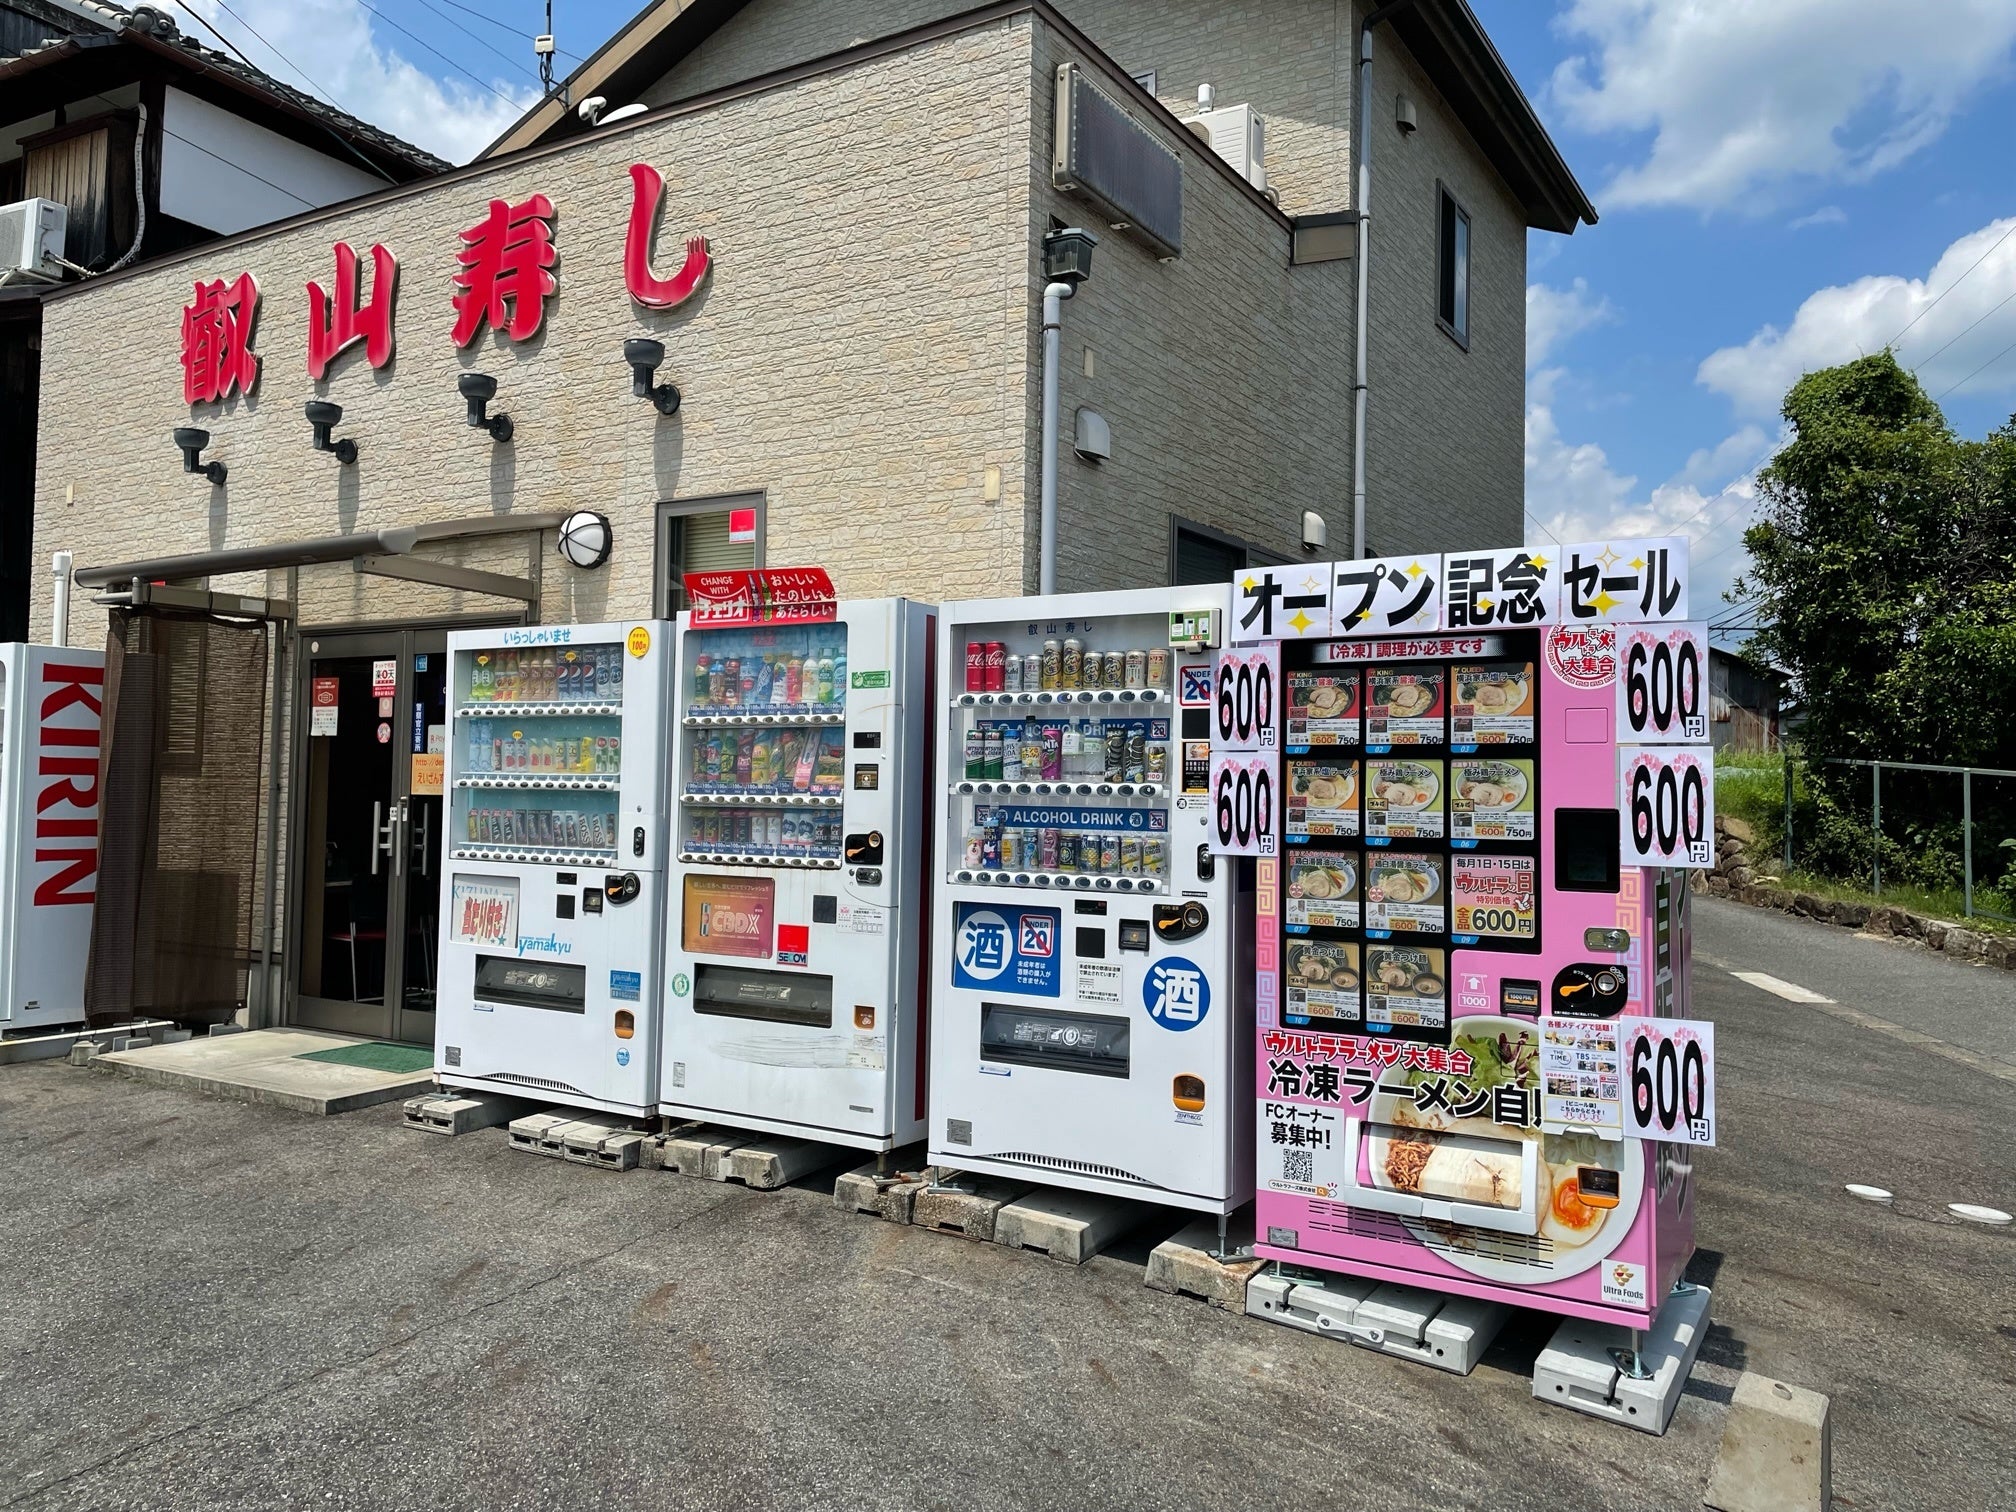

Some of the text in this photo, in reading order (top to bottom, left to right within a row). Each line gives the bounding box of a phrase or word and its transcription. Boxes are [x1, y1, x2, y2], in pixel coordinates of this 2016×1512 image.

[700, 576, 734, 586] CHANGE
[770, 573, 817, 587] おいしい
[709, 586, 730, 595] WITH
[775, 589, 822, 603] たのしい
[697, 596, 747, 620] チェリオ
[775, 604, 833, 619] あたらしい
[503, 628, 571, 645] いらっしゃいませ
[1027, 621, 1093, 636] 叡山寿し
[1328, 637, 1486, 660] 【冷凍】調理が必要です
[1563, 655, 1615, 674] 大集合
[1626, 640, 1705, 738] 600円
[1218, 662, 1275, 747] 600円
[34, 662, 105, 907] KIRIN
[1013, 810, 1124, 826] ALCOHOL DRINK
[1216, 767, 1275, 854] 600円
[1631, 764, 1710, 863] 600円
[579, 815, 592, 845] BOSS
[592, 815, 605, 846] BOSS
[1506, 826, 1532, 838] 750円
[1457, 858, 1531, 870] 毎月1日・15日は
[1454, 871, 1534, 895] ウルトラの日
[1476, 895, 1511, 905] 特別価格
[1419, 923, 1443, 932] 750円
[1457, 907, 1470, 931] 全品
[1472, 908, 1532, 933] 600円
[518, 933, 572, 957] yamakyu
[964, 920, 1005, 970] 酒
[1023, 929, 1048, 950] 20
[778, 952, 807, 964] SECOM
[1017, 960, 1046, 970] 未成年者は
[1152, 965, 1201, 1023] 酒
[1462, 996, 1487, 1007] 1000
[1335, 1009, 1358, 1019] 750円
[1420, 1017, 1445, 1027] 750円
[1547, 1020, 1614, 1032] 各種メディアで話題!
[1263, 1031, 1475, 1077] ウルトララーメン大集合
[1576, 1052, 1590, 1061] TBS
[1631, 1035, 1710, 1141] 600円
[1265, 1102, 1335, 1124] FCオーナー
[1270, 1121, 1331, 1150] 募集中!
[1603, 1285, 1644, 1300] Ultra Foods
